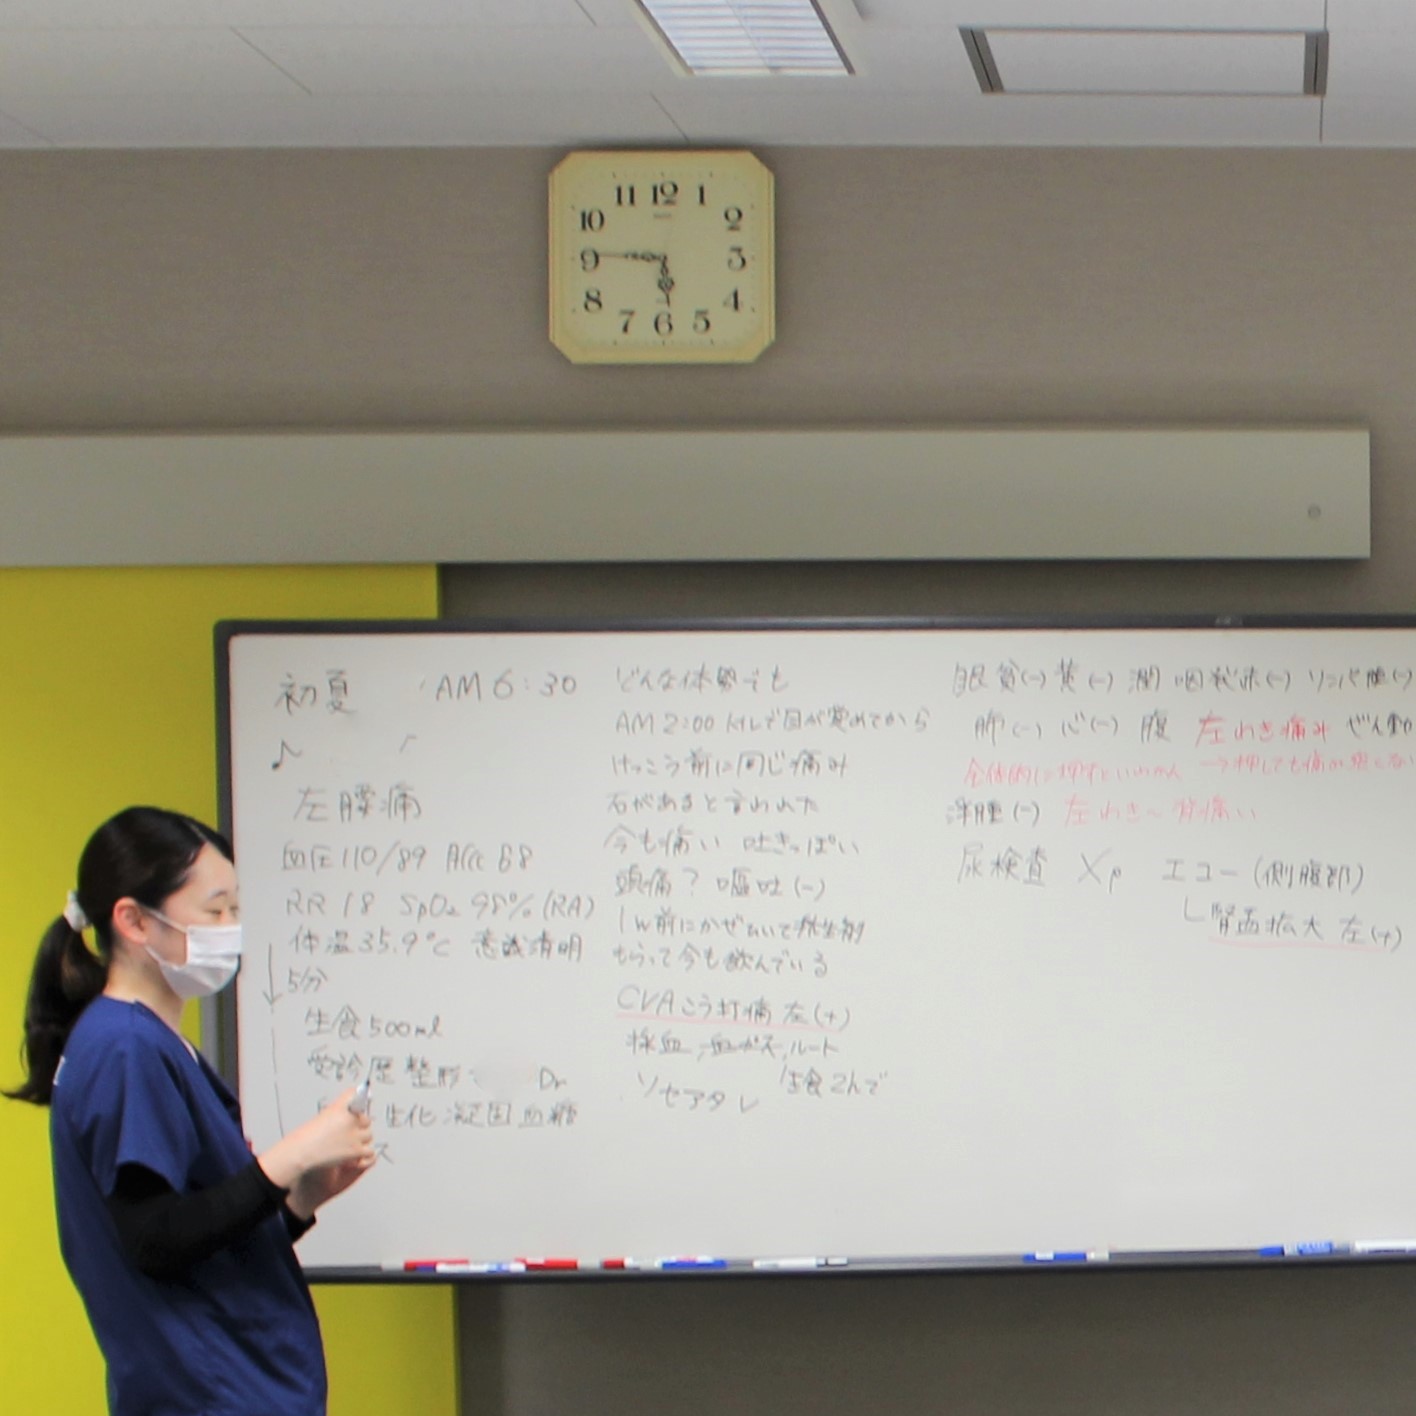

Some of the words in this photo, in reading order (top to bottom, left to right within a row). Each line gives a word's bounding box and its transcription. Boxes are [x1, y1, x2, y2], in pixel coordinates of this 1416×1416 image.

[616, 184, 636, 207] 11
[652, 180, 679, 206] 12
[698, 183, 707, 207] 1
[580, 208, 605, 232] 10
[723, 206, 743, 232] 2
[580, 248, 600, 273] 9
[727, 246, 747, 271] 3
[583, 287, 603, 313] 8
[722, 288, 743, 312] 4
[619, 310, 635, 334] 7
[653, 311, 673, 336] 6
[692, 310, 711, 334] 5
[435, 671, 482, 702] AM
[493, 669, 578, 701] 6:30
